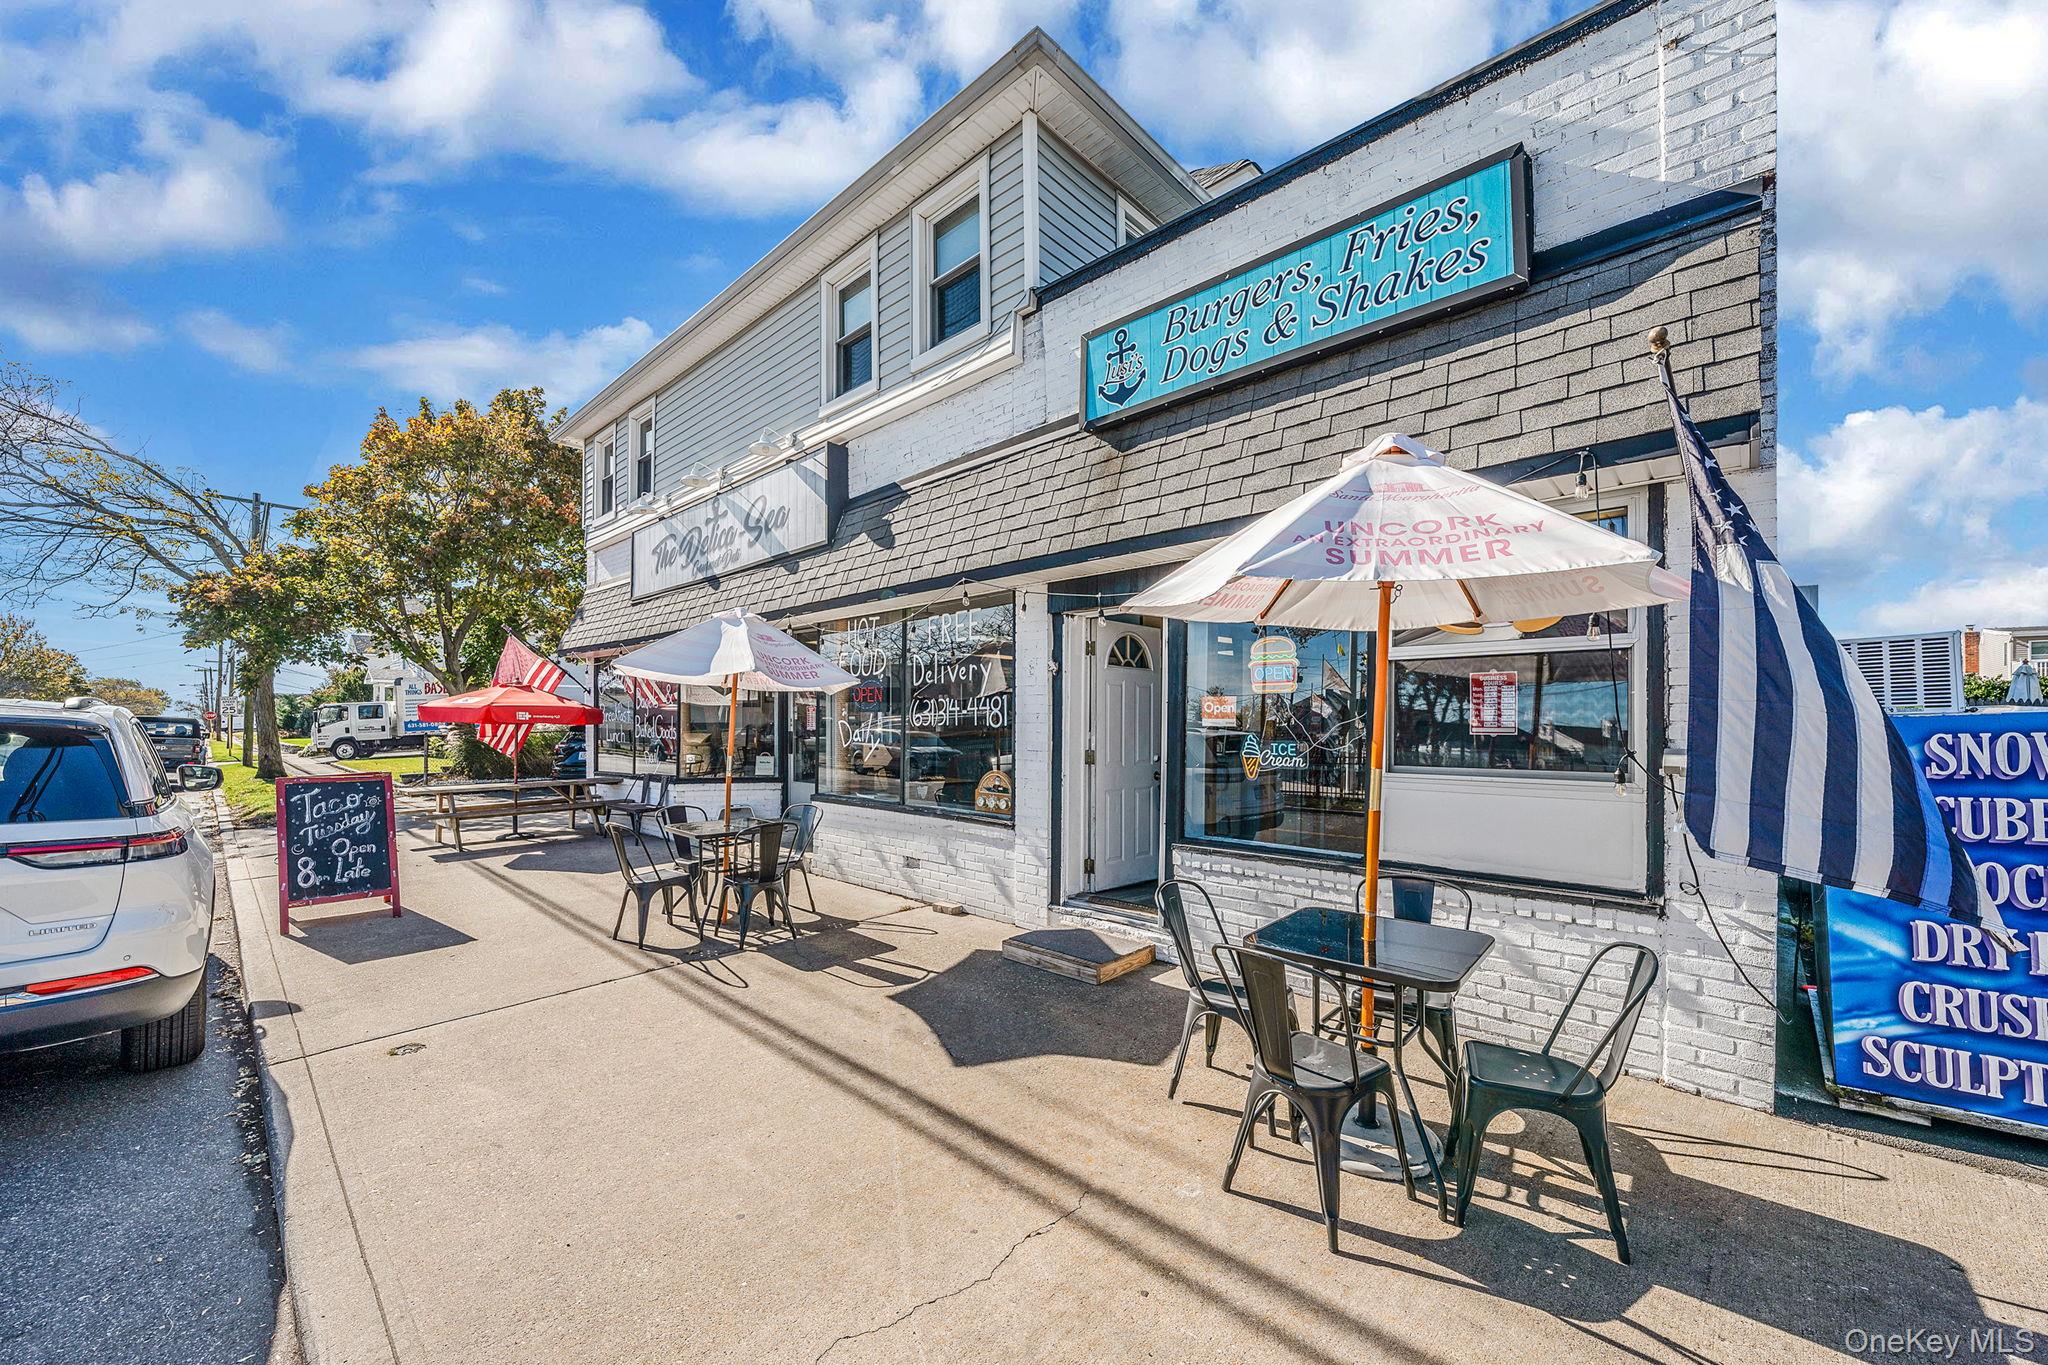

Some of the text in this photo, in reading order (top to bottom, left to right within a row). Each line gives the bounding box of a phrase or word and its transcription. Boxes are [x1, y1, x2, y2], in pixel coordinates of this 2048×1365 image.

[1161, 196, 1480, 347] Burgers, Fries,
[1160, 237, 1492, 384] Dogs & Shakes
[1104, 353, 1143, 386] Lusi's
[1324, 513, 1504, 538] UNCORK
[1334, 519, 1546, 547] EXTRAORDINARY
[652, 533, 678, 575] The
[1325, 538, 1515, 567] SUMMER
[847, 616, 881, 646] HOT
[928, 607, 982, 645] FREE
[838, 648, 887, 677] FOOD
[913, 651, 992, 697] Delivery
[1254, 666, 1293, 681] OPEN
[853, 686, 883, 703] OPEN
[1203, 702, 1236, 716] Open
[222, 706, 236, 714] 25
[909, 695, 1008, 728] (631)314-4481
[838, 712, 881, 762] Daily
[1270, 742, 1297, 756] ICE
[1259, 750, 1306, 767] Cream
[290, 787, 363, 824] Taco
[299, 810, 377, 847] Tuesday
[331, 837, 377, 862] Open
[335, 856, 372, 884] Late
[1910, 919, 2018, 972] DRY
